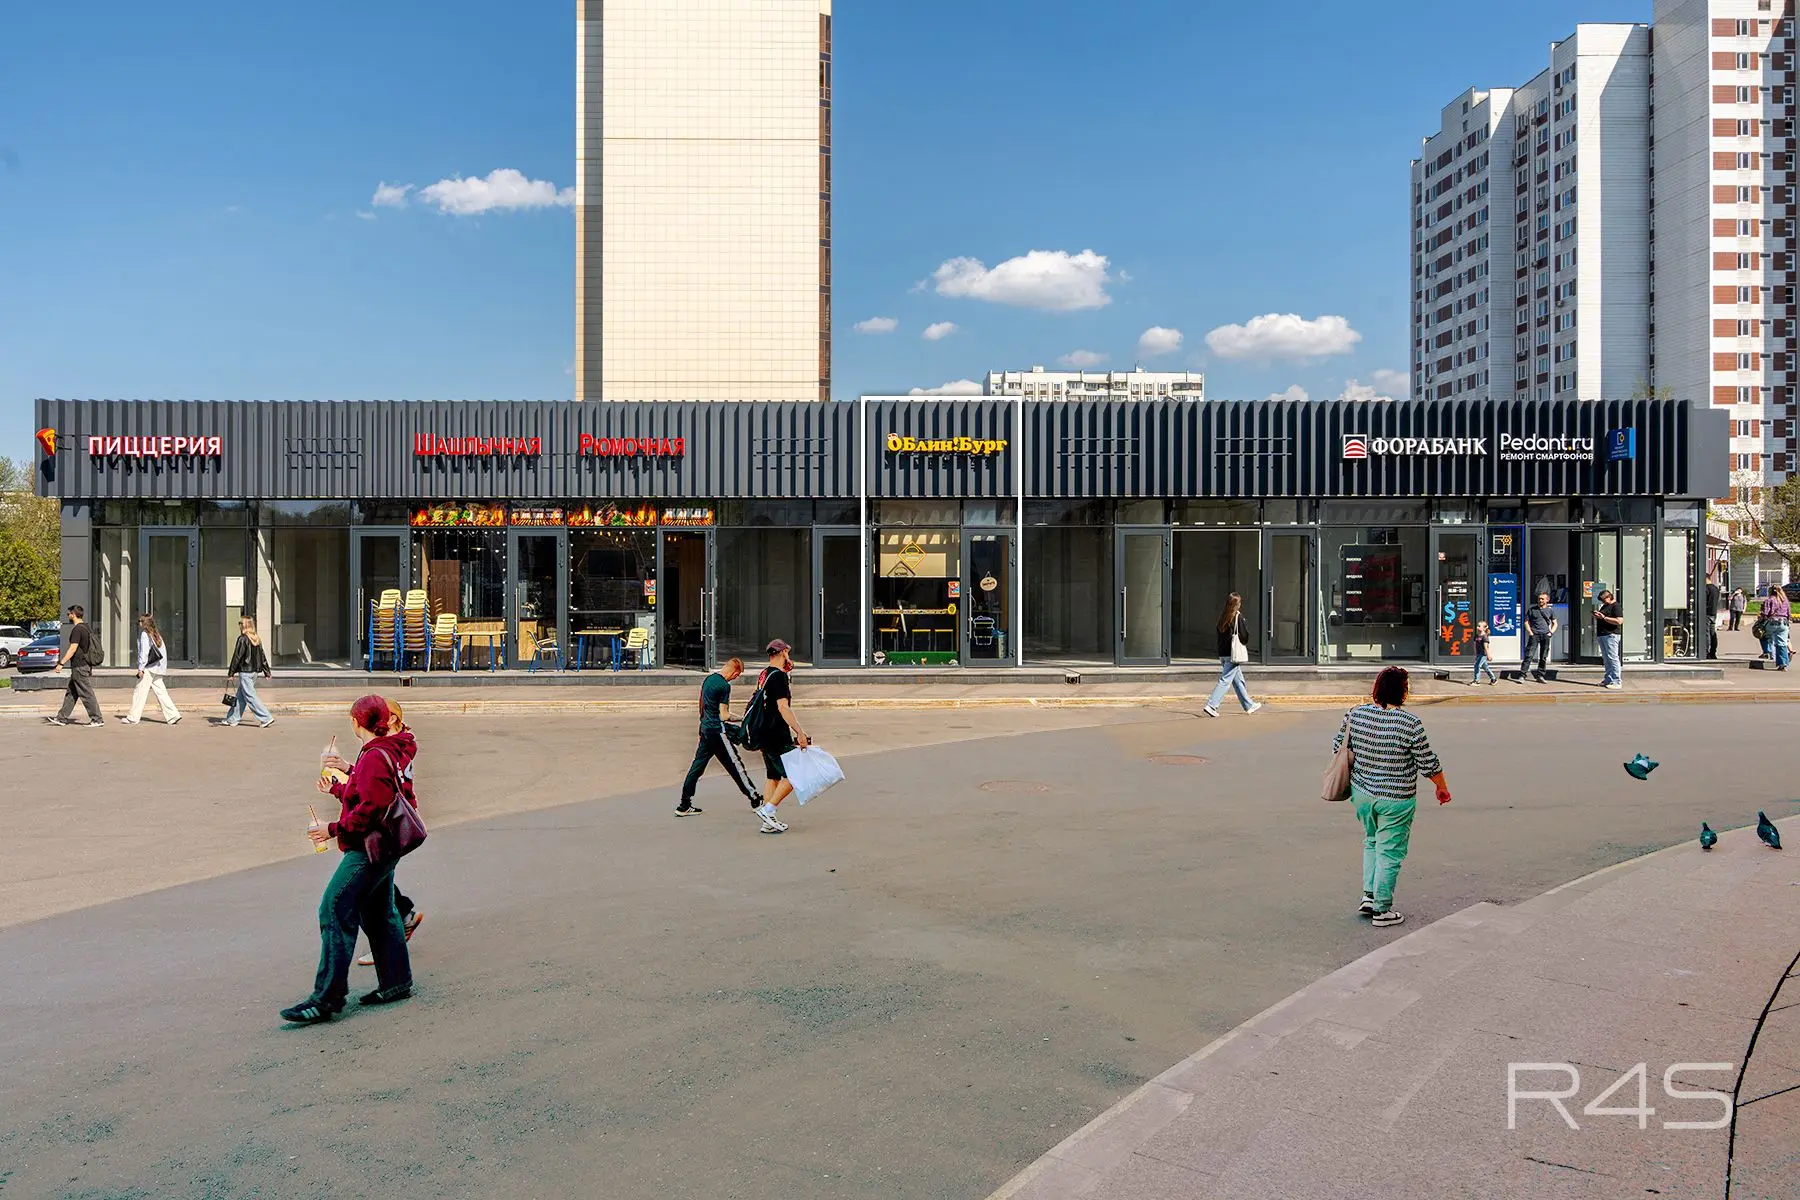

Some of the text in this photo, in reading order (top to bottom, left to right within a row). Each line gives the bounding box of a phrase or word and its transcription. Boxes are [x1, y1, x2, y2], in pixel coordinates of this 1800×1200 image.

[88, 436, 222, 458] ПИЦЦЕРИЯ
[1371, 437, 1488, 455] ФОРАБАНК
[1500, 432, 1594, 451] Pedant.ru
